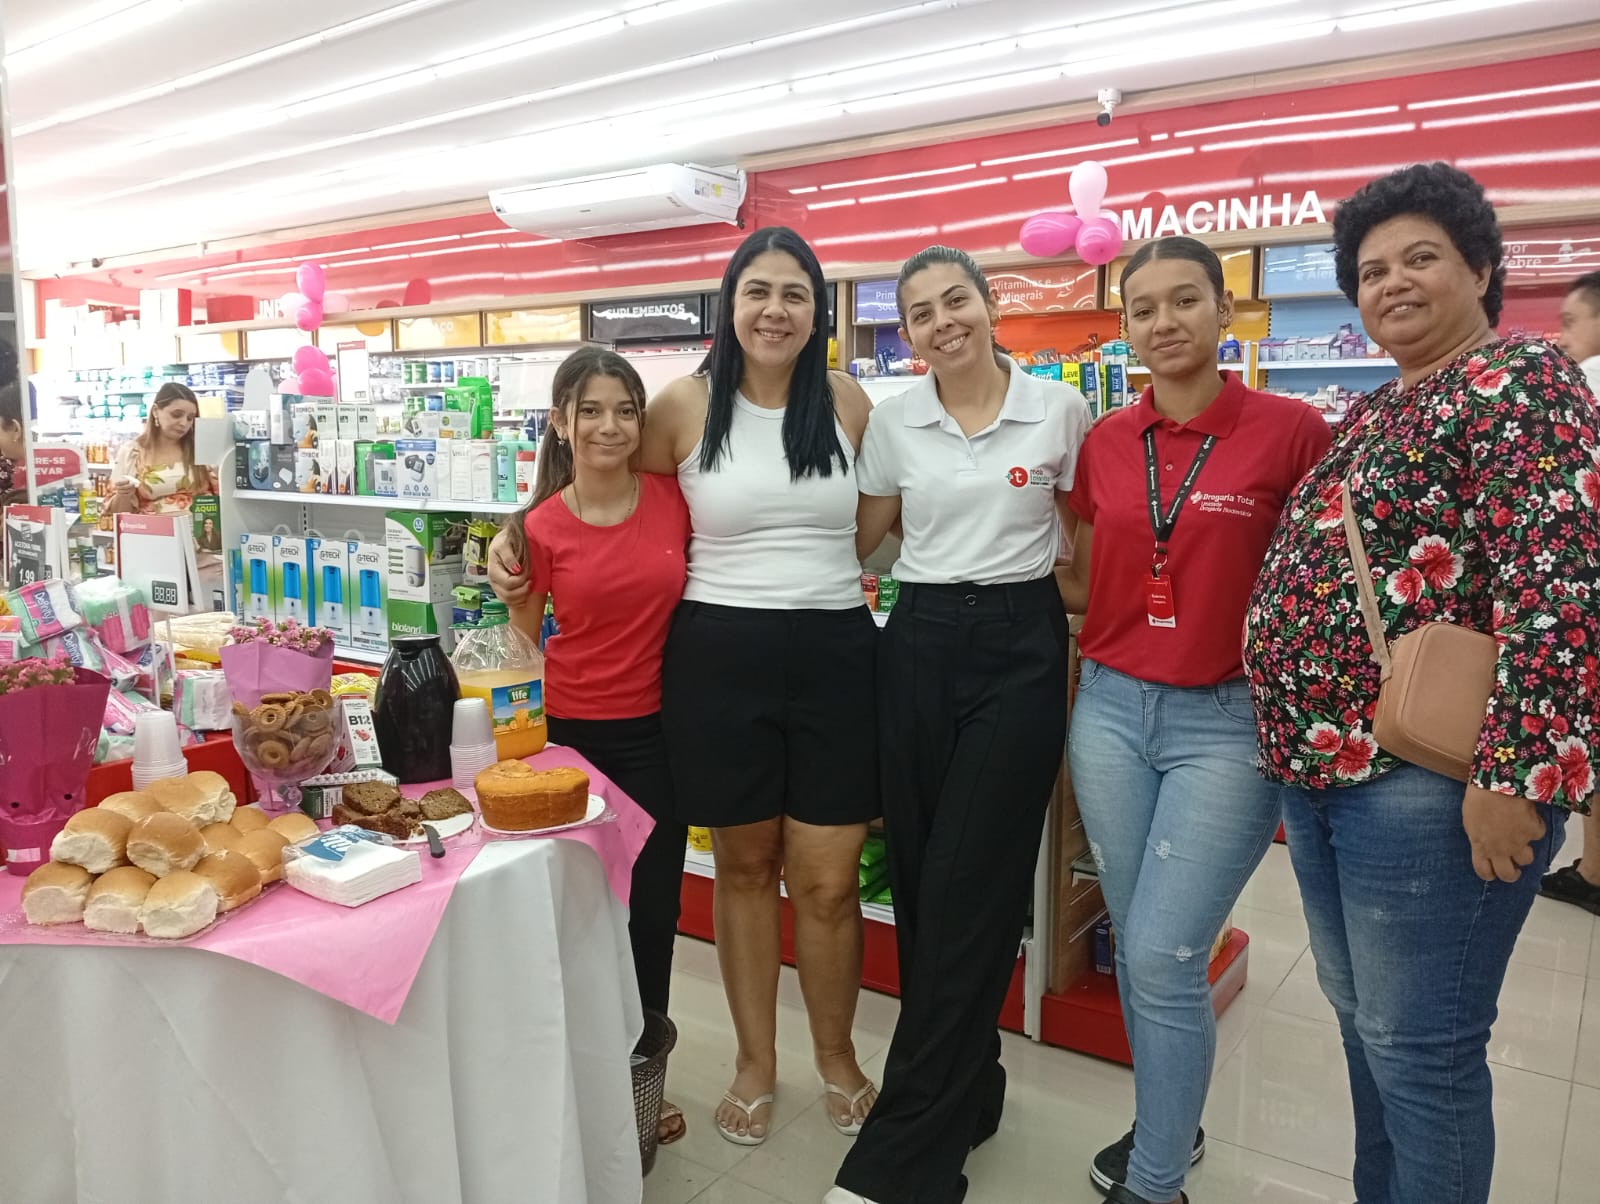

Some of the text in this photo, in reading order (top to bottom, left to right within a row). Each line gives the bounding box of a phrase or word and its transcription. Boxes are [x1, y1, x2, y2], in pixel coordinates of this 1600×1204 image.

[1121, 190, 1327, 241] MACINHA
[1503, 257, 1542, 268] ebre
[875, 290, 897, 300] Prim
[1000, 290, 1044, 302] Minerais
[1063, 371, 1079, 379] LEVE
[35, 456, 66, 465] RE-SE
[35, 467, 64, 475] EVAR
[1014, 470, 1023, 483] t
[1202, 493, 1255, 506] Drogaria Total
[320, 550, 341, 560] G-TECH
[357, 553, 379, 564] G-TECH
[18, 567, 36, 585] 1,99
[511, 689, 528, 702] life
[348, 714, 372, 726] B12
